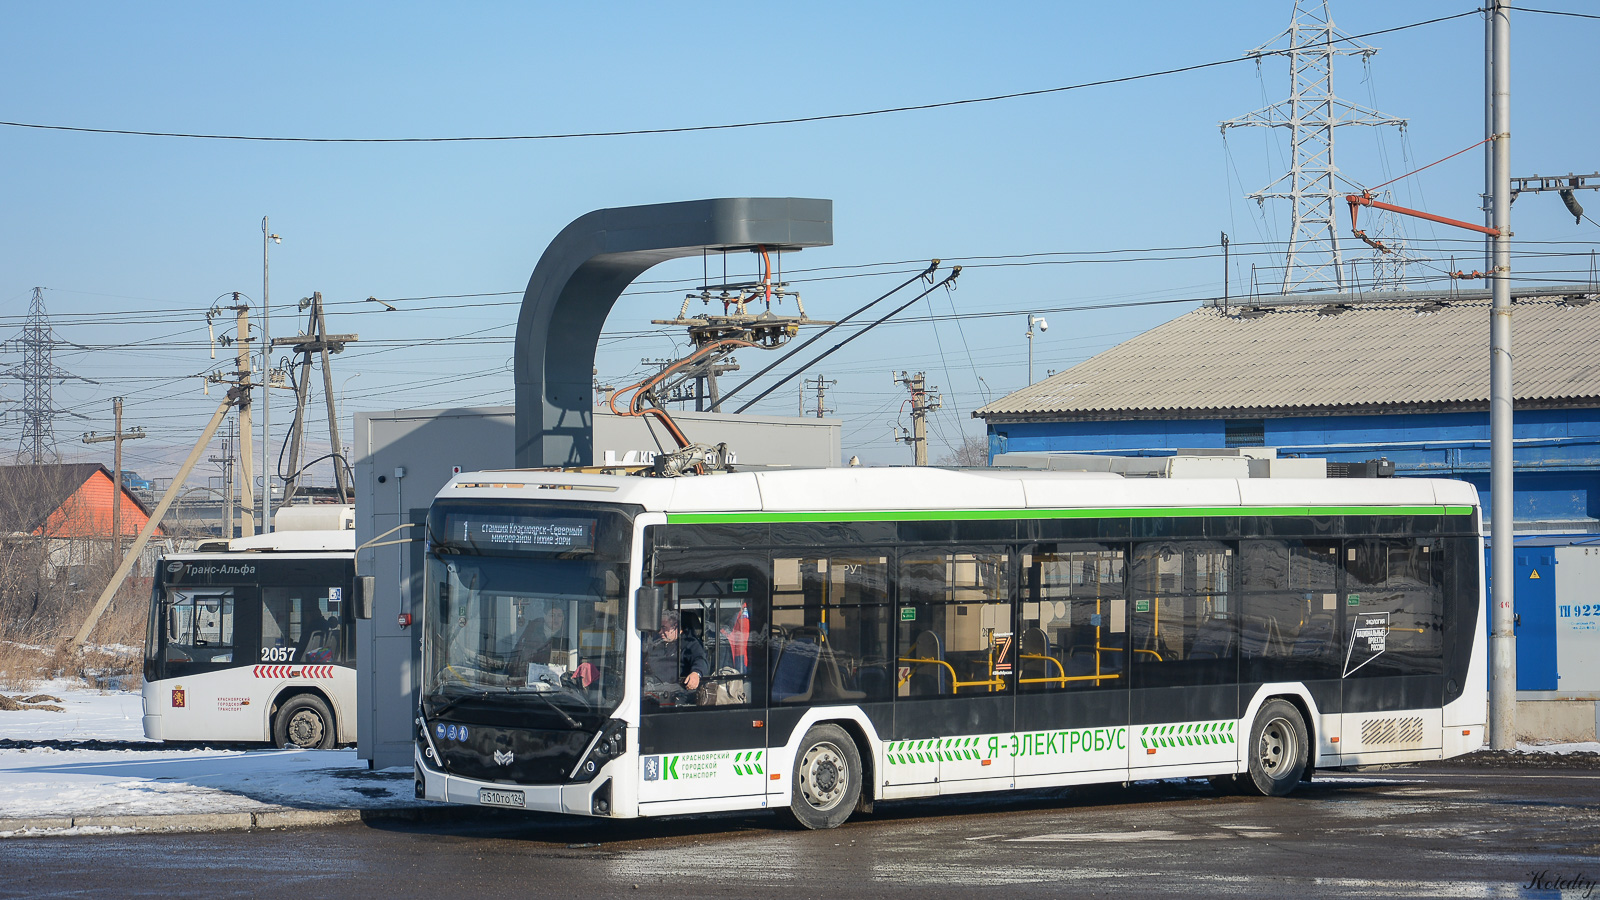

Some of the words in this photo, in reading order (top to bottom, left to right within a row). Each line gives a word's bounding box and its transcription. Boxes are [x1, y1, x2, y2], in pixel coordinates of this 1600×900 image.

[186, 564, 256, 577] Транс-Альфа
[261, 647, 296, 662] 2057
[987, 727, 1126, 759] Я-ЭЛЕКТРОБУС
[681, 751, 730, 762] КРАСНОЯРСКИЙ
[681, 762, 717, 771] ГОРОДСКОЙ
[681, 771, 717, 780] ТРАНСПОРТ
